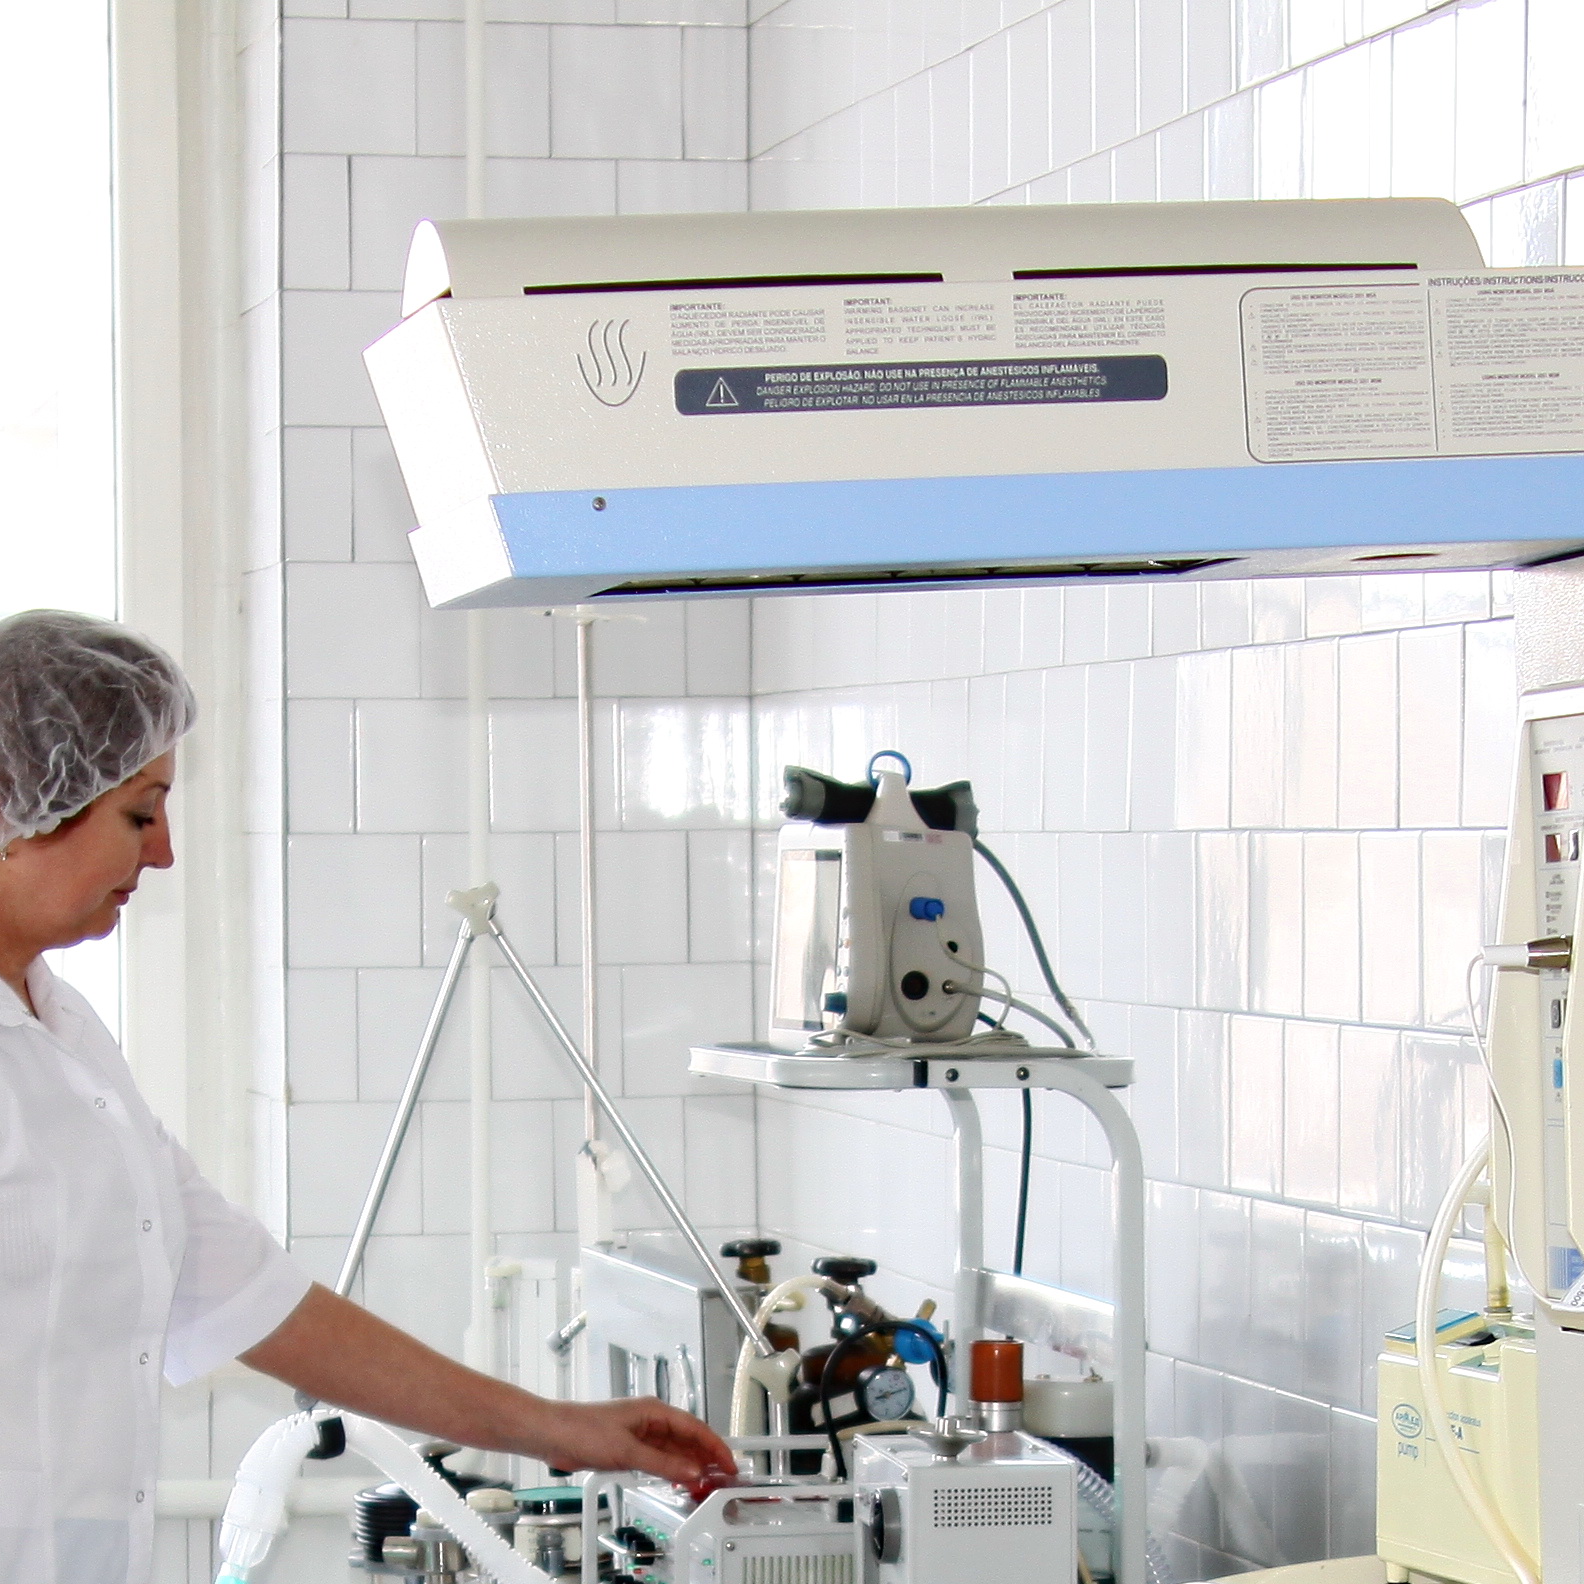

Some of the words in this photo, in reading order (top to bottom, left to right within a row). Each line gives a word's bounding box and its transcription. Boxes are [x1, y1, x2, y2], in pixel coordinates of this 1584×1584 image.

[765, 373, 798, 383] PERIGO
[800, 372, 811, 382] DE
[886, 369, 903, 379] USE
[967, 367, 978, 377] DE
